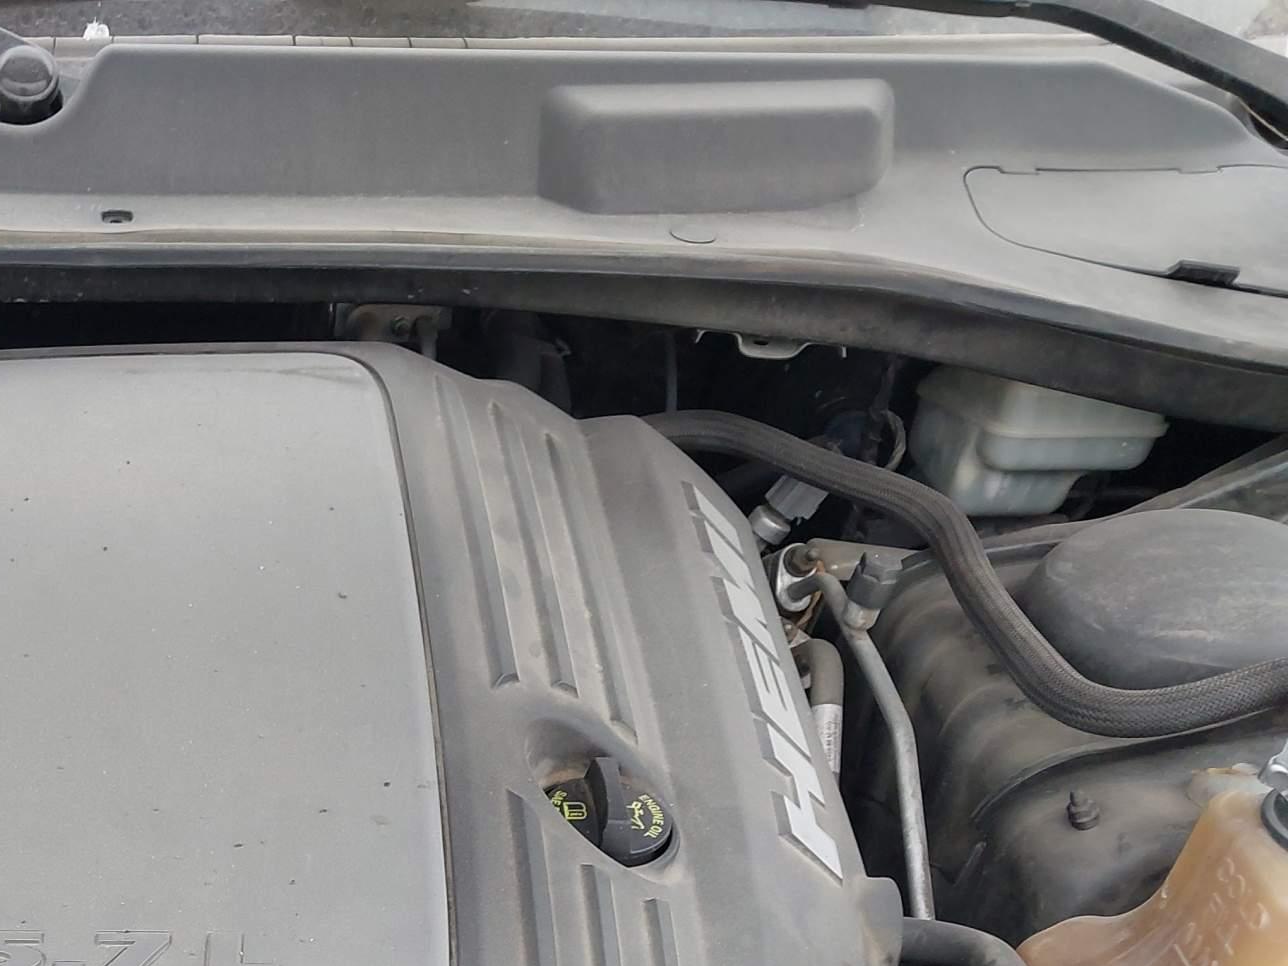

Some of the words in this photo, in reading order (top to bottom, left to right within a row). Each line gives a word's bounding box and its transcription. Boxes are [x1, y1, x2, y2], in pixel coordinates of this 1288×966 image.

[685, 484, 843, 884] HEMI
[638, 794, 665, 827] ENGINE
[643, 825, 663, 838] OIL
